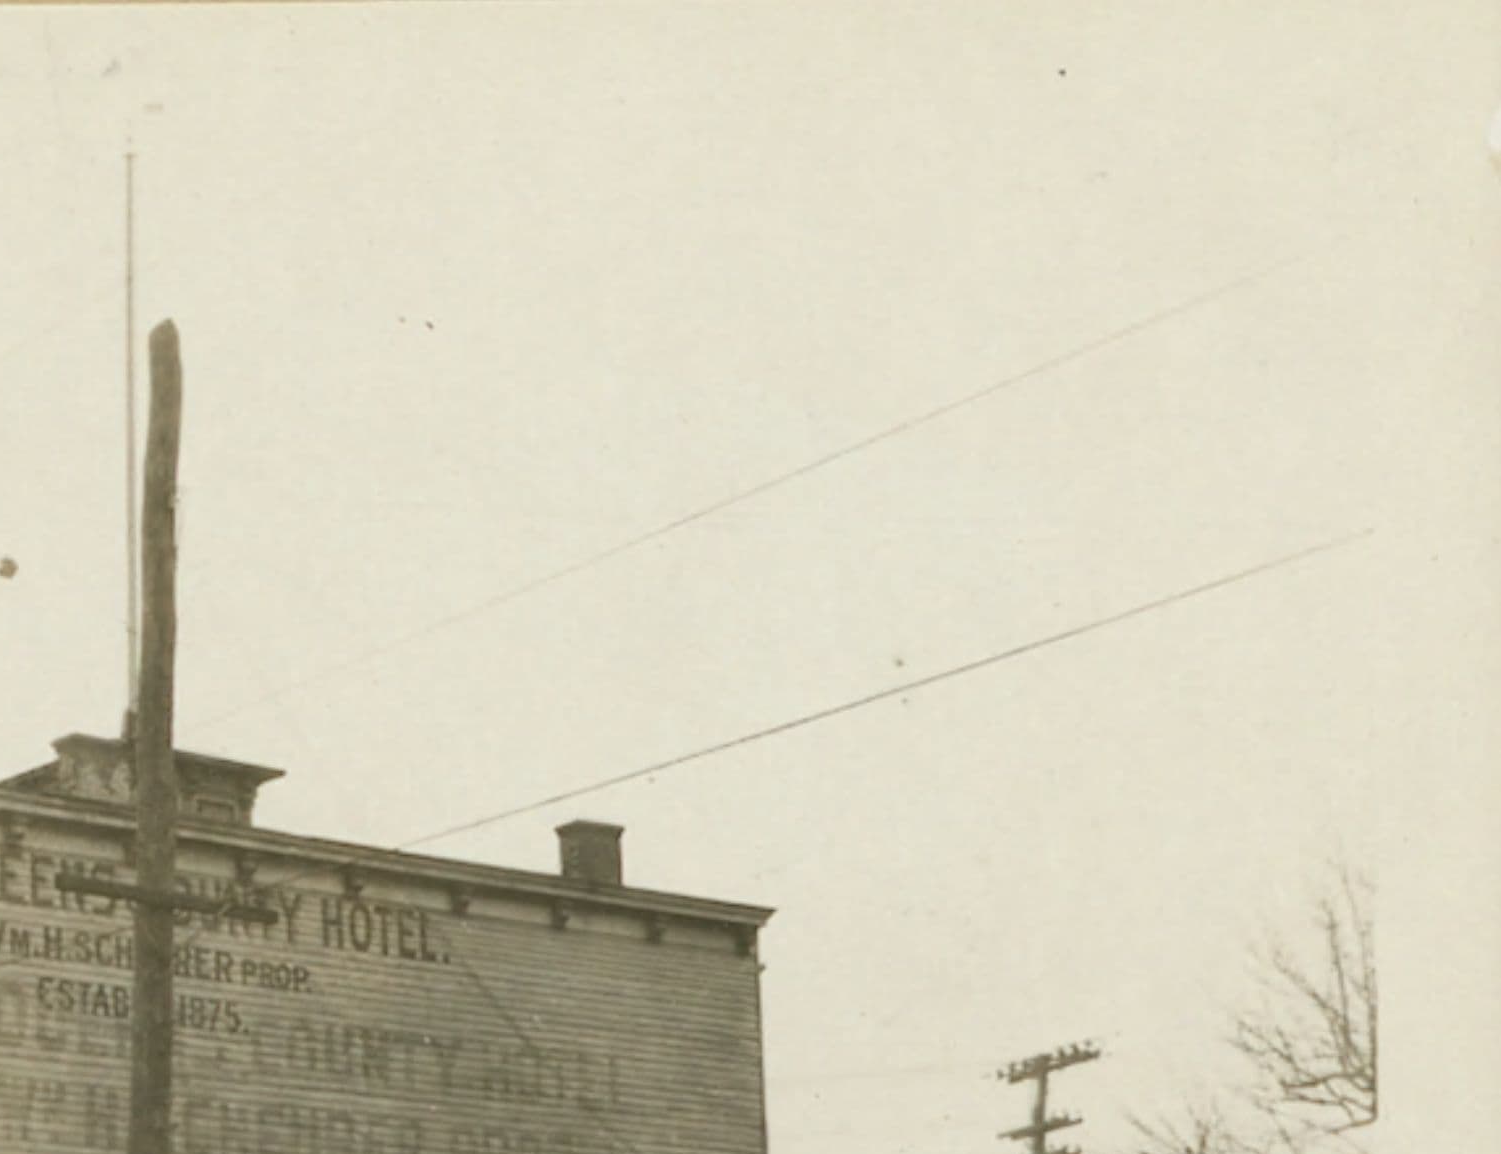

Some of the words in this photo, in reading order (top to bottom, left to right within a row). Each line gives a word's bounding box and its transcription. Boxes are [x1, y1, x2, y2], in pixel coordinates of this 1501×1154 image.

[172, 876, 301, 946] OUNTY
[321, 898, 450, 965] HOTEL.
[75, 930, 234, 983] SCHRER
